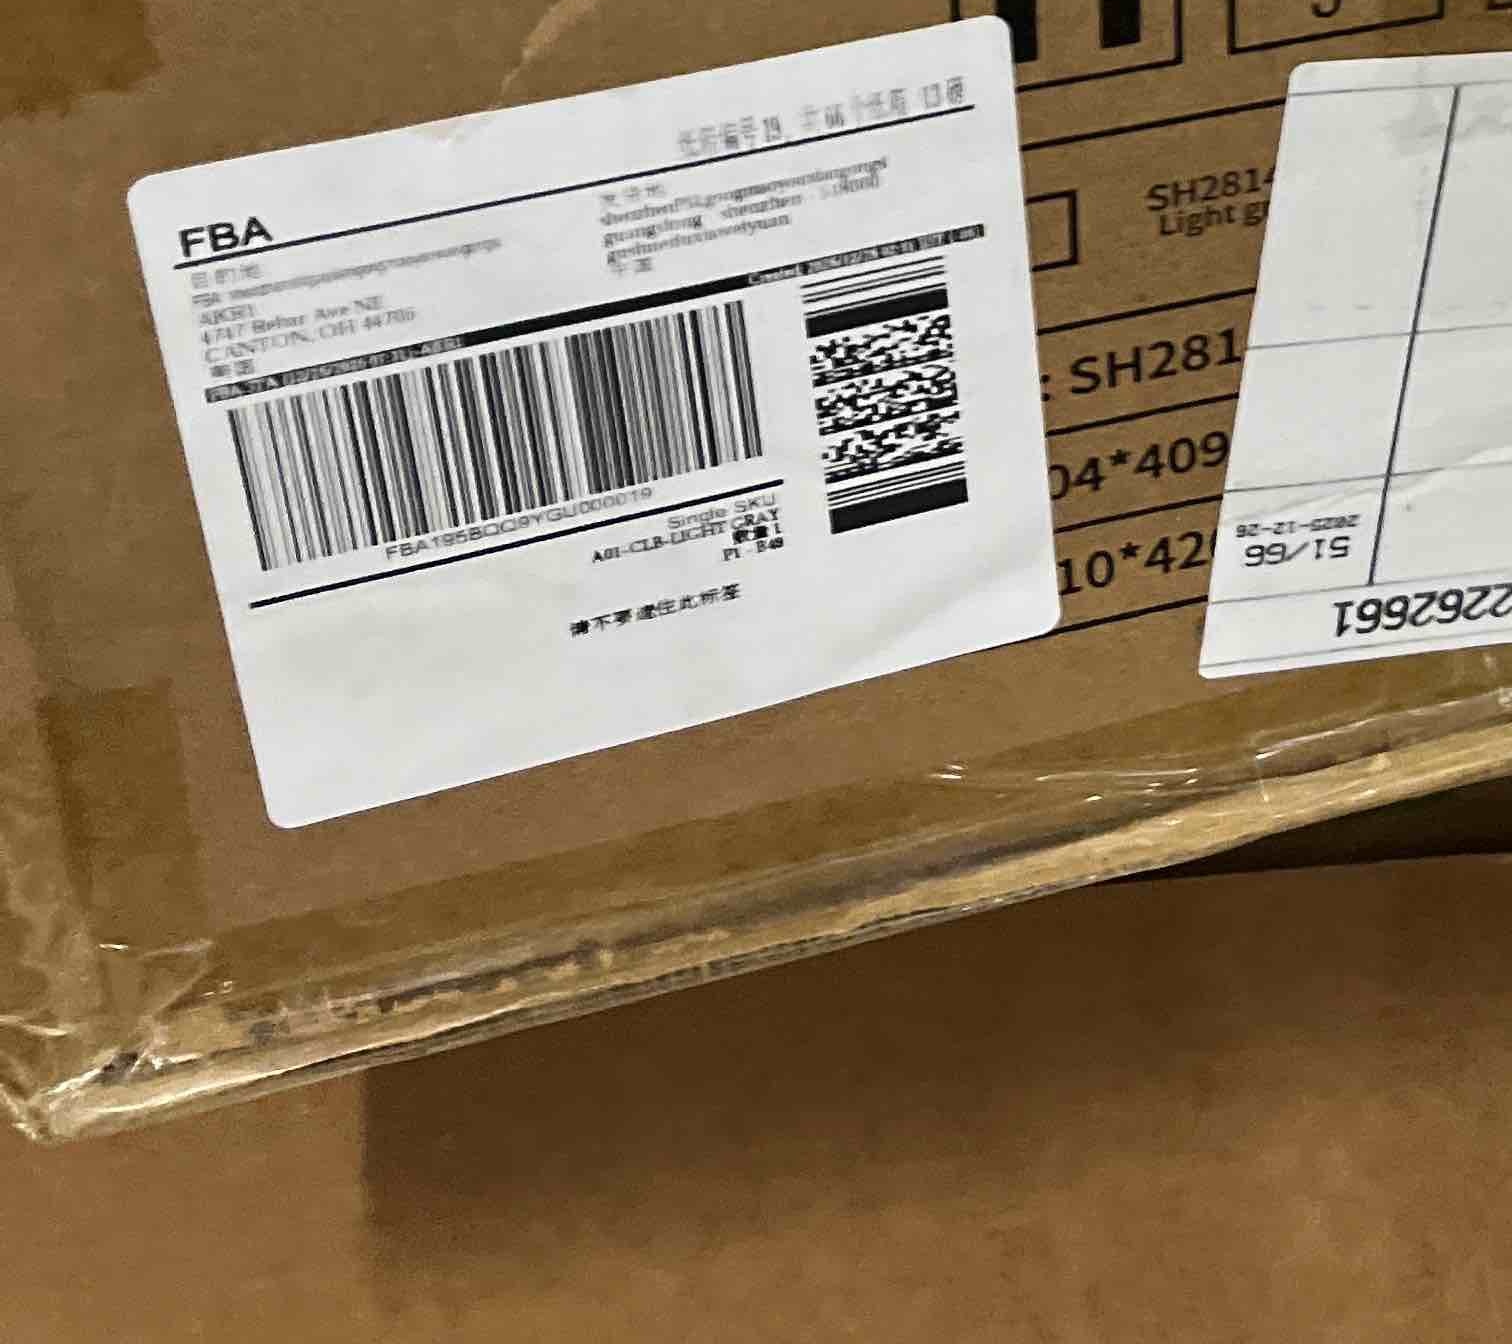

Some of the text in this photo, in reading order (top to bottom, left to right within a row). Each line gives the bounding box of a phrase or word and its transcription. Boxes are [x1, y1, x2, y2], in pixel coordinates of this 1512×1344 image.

[177, 215, 273, 258] FBA
[1159, 203, 1236, 237] Light
[1070, 328, 1241, 395] SH281
[666, 491, 776, 531] Single SKU
[729, 506, 780, 531] GRAY
[1241, 534, 1351, 568] 51/66
